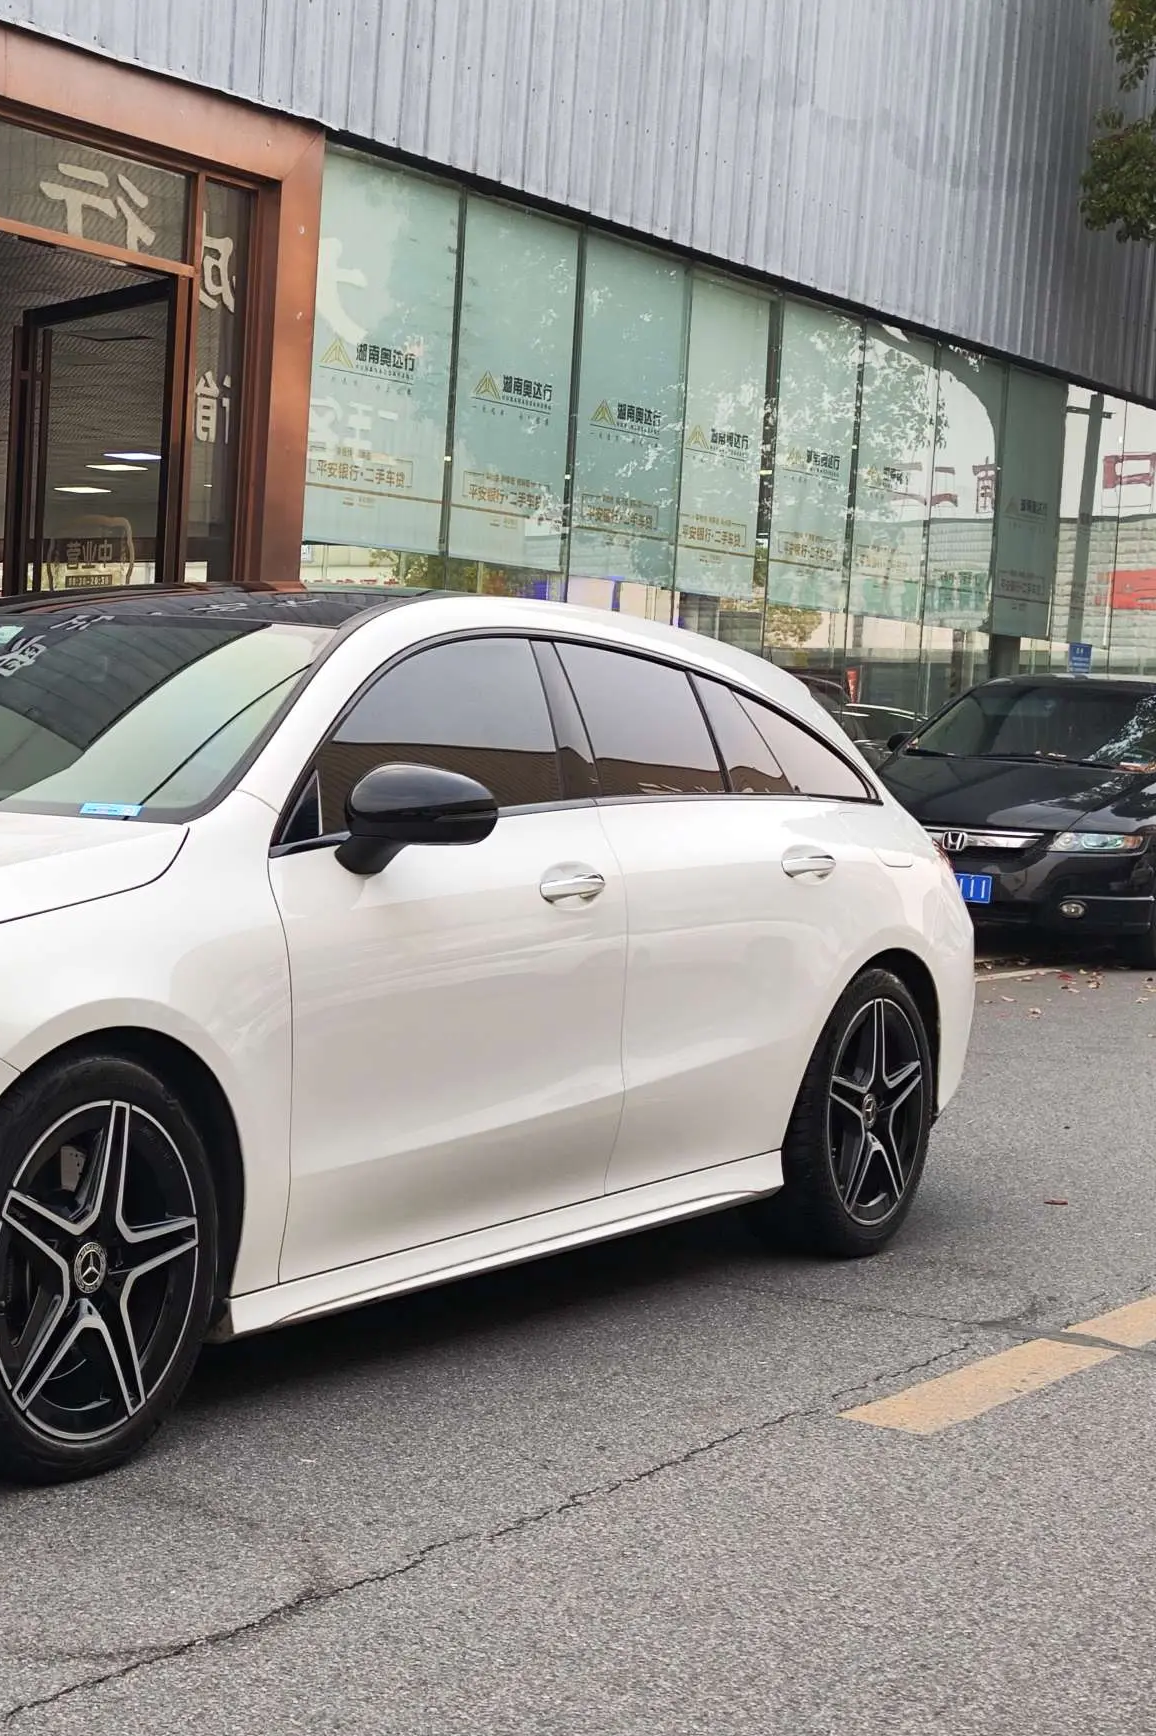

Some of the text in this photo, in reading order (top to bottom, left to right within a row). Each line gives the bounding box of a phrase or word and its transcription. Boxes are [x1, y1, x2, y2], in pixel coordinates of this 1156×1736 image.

[355, 343, 416, 372] 湖南奥达行
[502, 374, 553, 402] 湖南奥达行
[66, 539, 113, 570] 营业中
